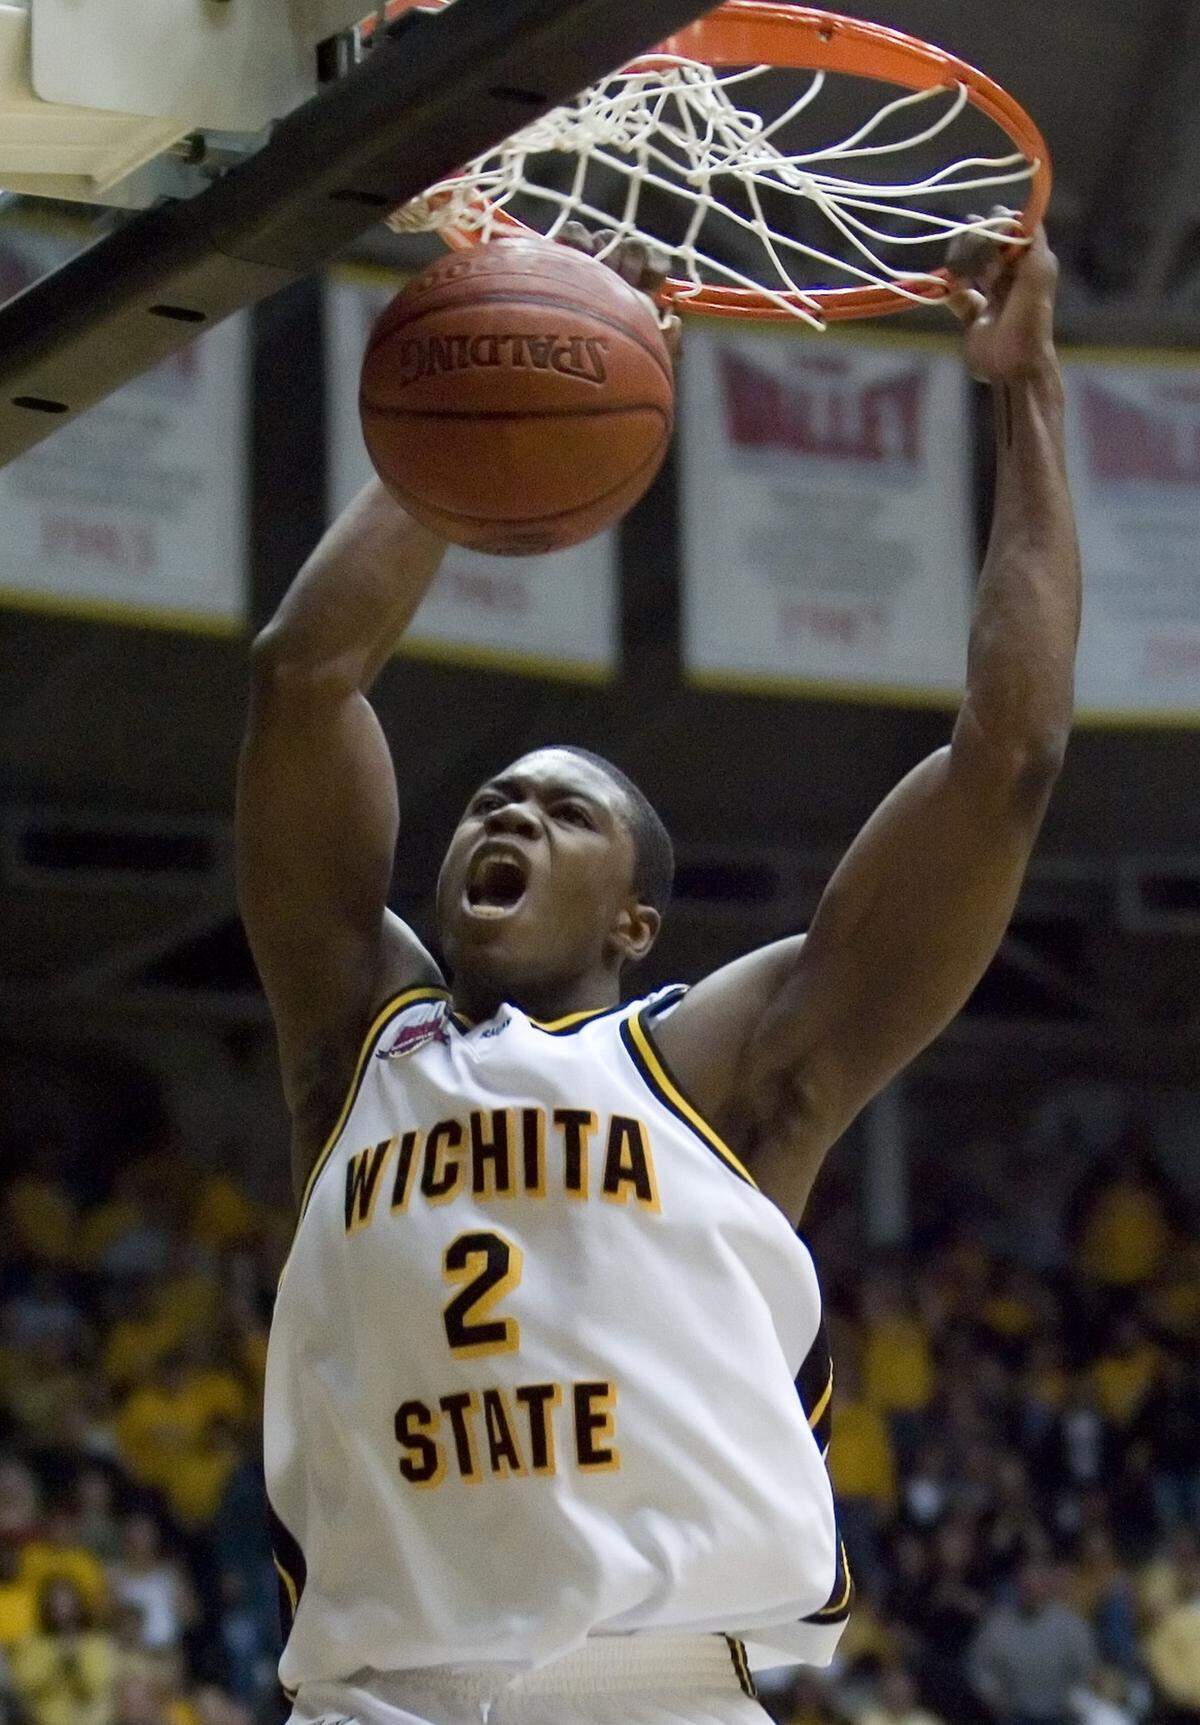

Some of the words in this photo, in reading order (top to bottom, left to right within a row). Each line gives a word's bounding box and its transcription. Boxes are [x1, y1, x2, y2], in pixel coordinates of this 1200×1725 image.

[400, 333, 611, 388] SPALDING
[344, 1107, 662, 1236] WICHITA
[442, 1229, 523, 1360] 2
[394, 1380, 620, 1490] STATE
